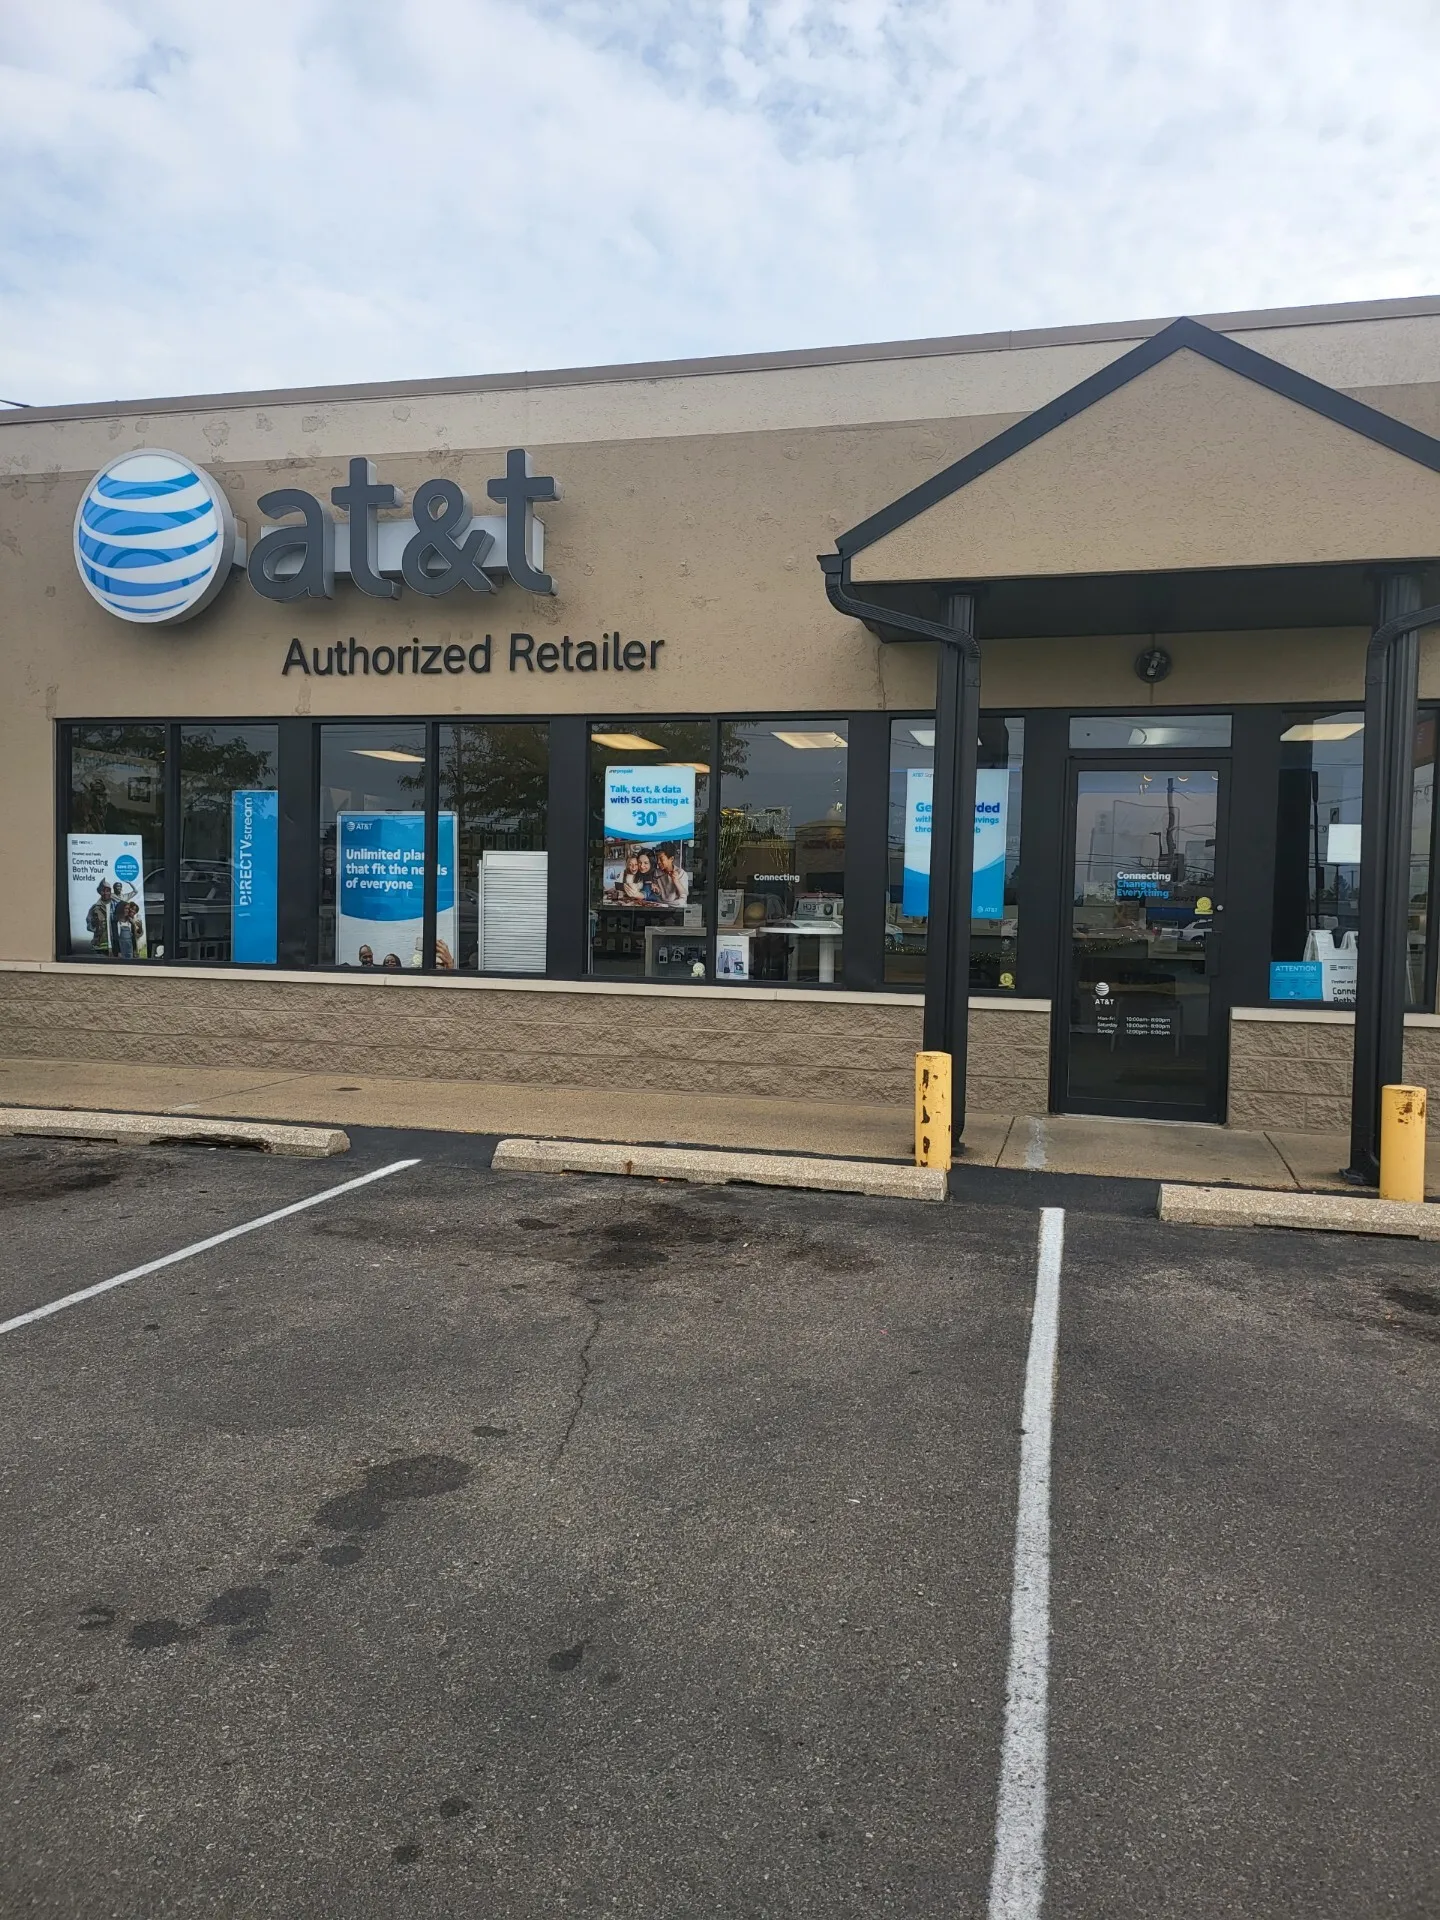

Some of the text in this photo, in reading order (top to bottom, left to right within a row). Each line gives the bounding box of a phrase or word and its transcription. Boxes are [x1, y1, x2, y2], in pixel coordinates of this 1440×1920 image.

[282, 631, 665, 676] Authorized Retailer
[610, 785, 631, 794] Talk,
[632, 785, 653, 794] text,
[662, 785, 682, 793] data
[610, 796, 689, 806] with 5G starting at
[632, 811, 658, 827] $30
[346, 848, 401, 860] Unlimited
[72, 858, 108, 866] Connecting
[345, 863, 369, 875] that
[371, 863, 386, 875] fit
[388, 863, 408, 875] the
[754, 873, 801, 883] Connecting
[1117, 871, 1171, 882] Connecting
[345, 877, 414, 892] of everyone
[1117, 880, 1157, 889] Changes
[1117, 889, 1170, 899] Everything
